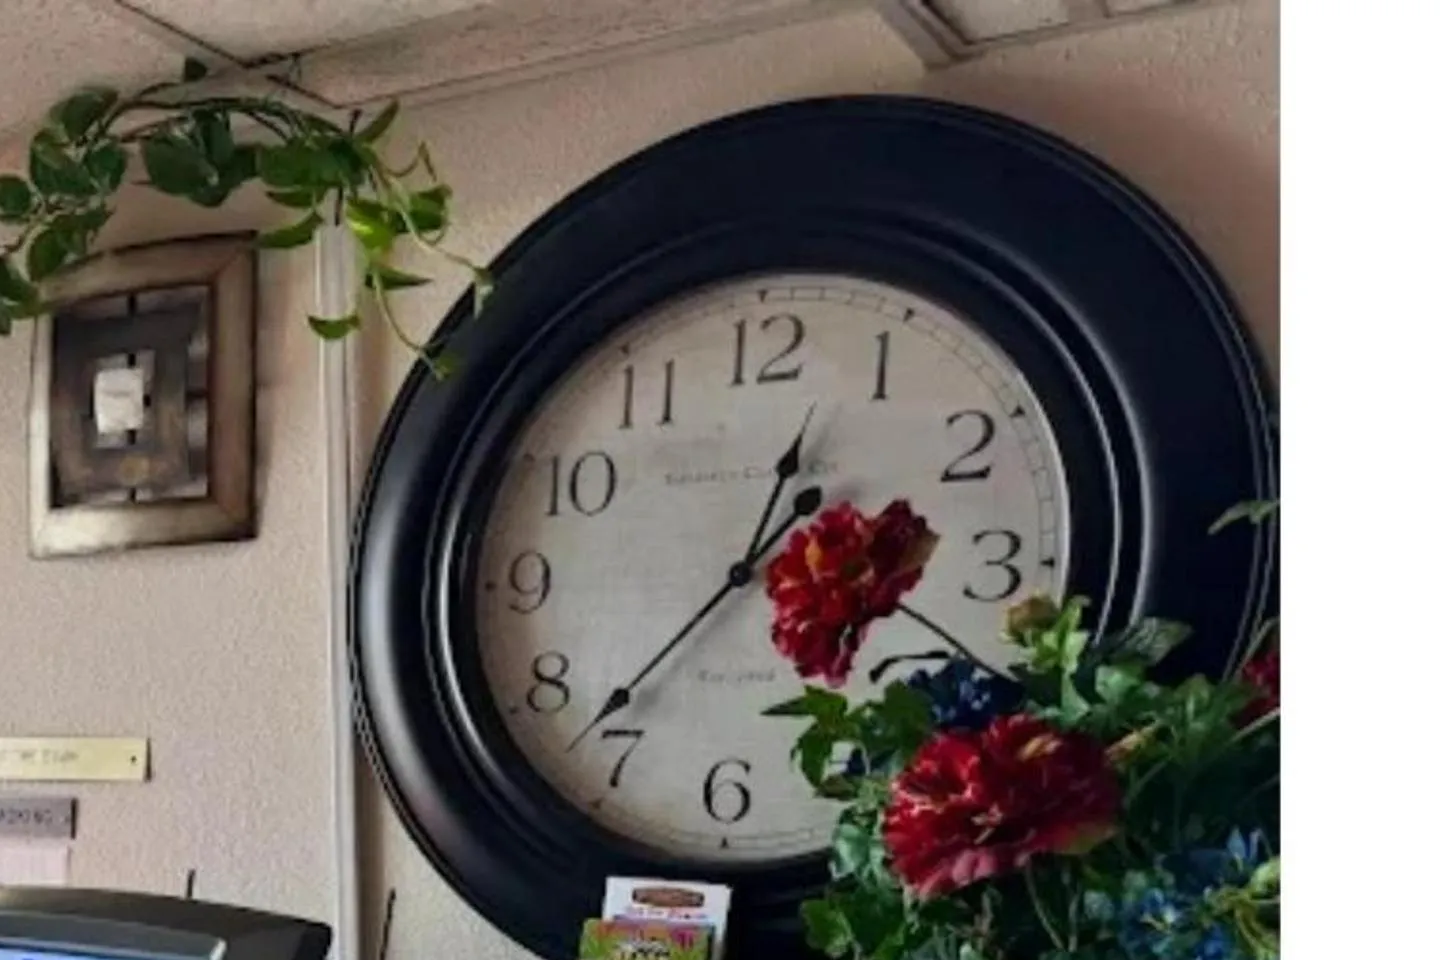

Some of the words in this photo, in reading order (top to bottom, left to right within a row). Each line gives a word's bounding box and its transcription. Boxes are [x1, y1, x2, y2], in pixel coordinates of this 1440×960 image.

[730, 313, 806, 387] 12
[872, 330, 891, 400] 1
[619, 360, 676, 429] 11
[940, 410, 996, 483] 2
[545, 451, 618, 518] 10
[509, 553, 552, 614] 9
[963, 529, 1022, 601] 3
[526, 652, 571, 713] 8
[601, 729, 645, 788] 7
[703, 760, 752, 824] 6
